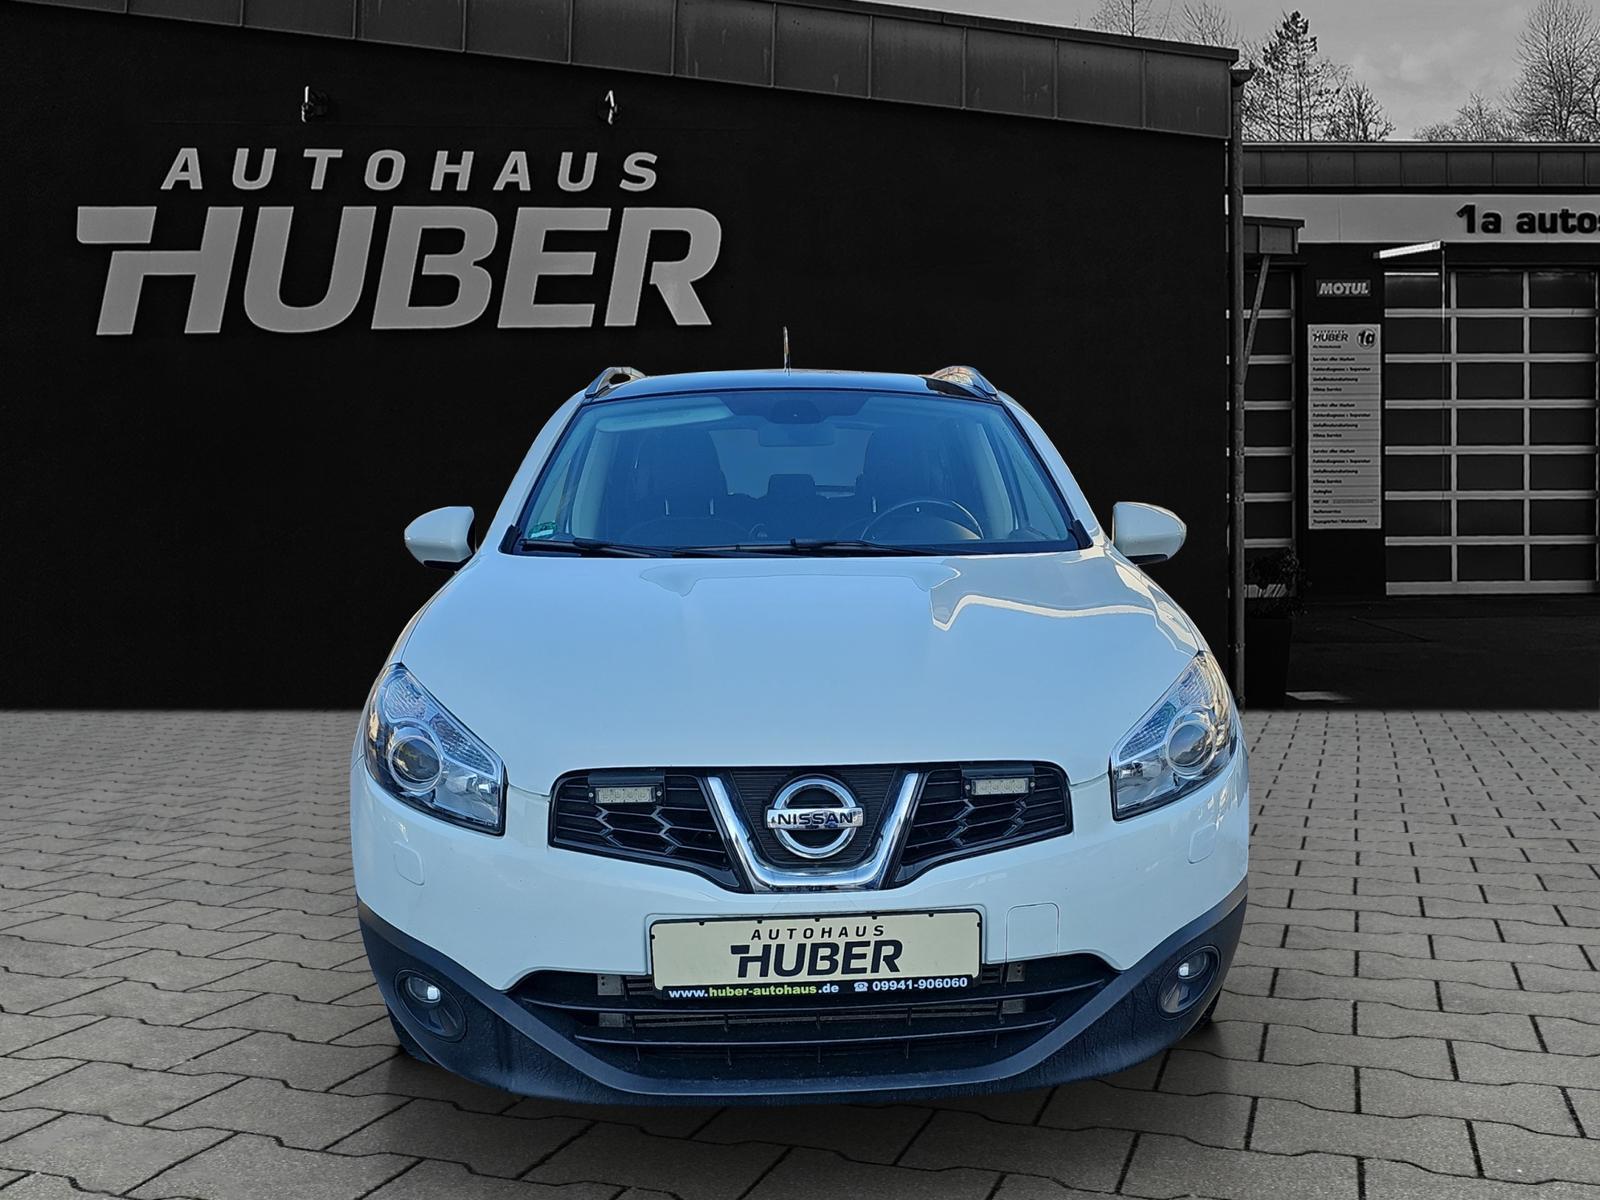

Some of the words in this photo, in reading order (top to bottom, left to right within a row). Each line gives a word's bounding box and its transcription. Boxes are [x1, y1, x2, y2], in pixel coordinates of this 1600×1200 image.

[160, 147, 658, 192] AUTOHAUS
[1456, 204, 1502, 234] 1a
[1516, 208, 1600, 234] auto
[76, 205, 722, 335] HUBER
[1319, 282, 1369, 295] MOTUL
[777, 811, 853, 826] NISSAN
[750, 924, 885, 941] AUTOHAUS
[730, 939, 903, 979] HUBER
[668, 983, 839, 999] www.huber-autohaus.de
[872, 977, 968, 992] 09941-906060
